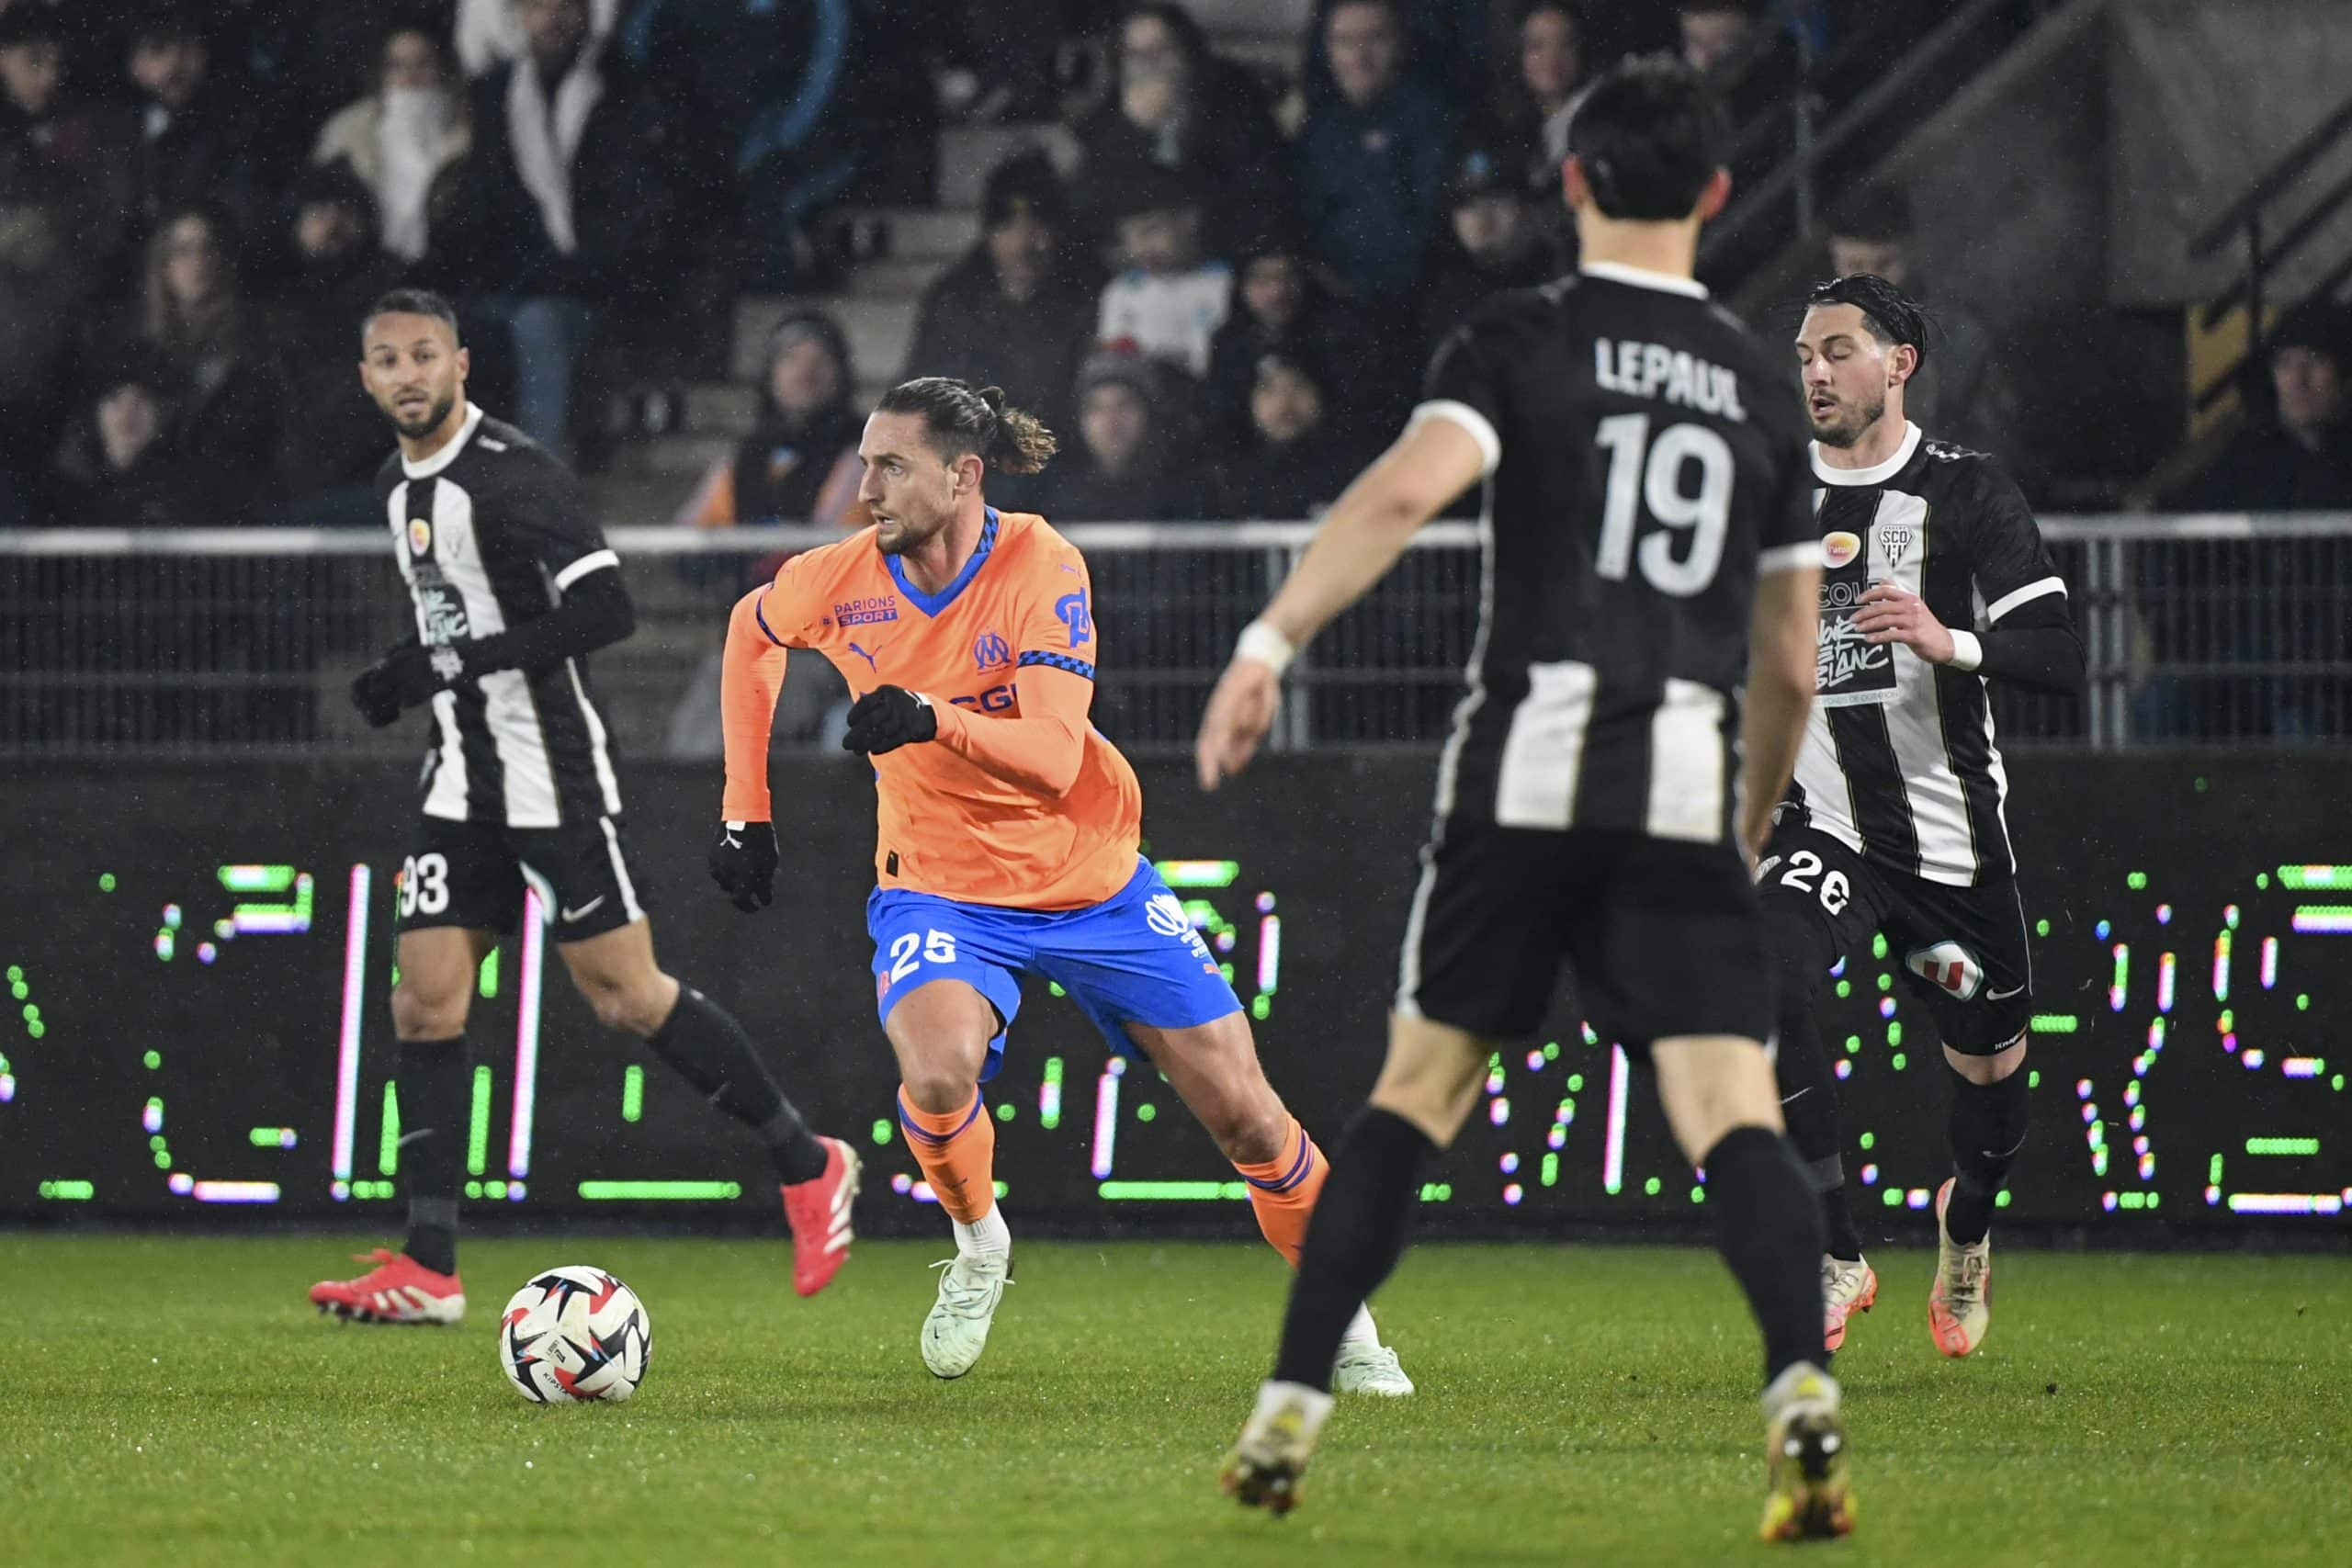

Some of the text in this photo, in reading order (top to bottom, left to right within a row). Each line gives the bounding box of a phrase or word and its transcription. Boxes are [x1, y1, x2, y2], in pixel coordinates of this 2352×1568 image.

[1594, 336, 1747, 423] LEPAUL
[1593, 412, 1735, 597] 19
[1882, 530, 1909, 544] SCO
[834, 594, 897, 616] PARIONS
[839, 608, 897, 626] SPORT
[401, 852, 450, 918] 93
[889, 928, 956, 986] 25
